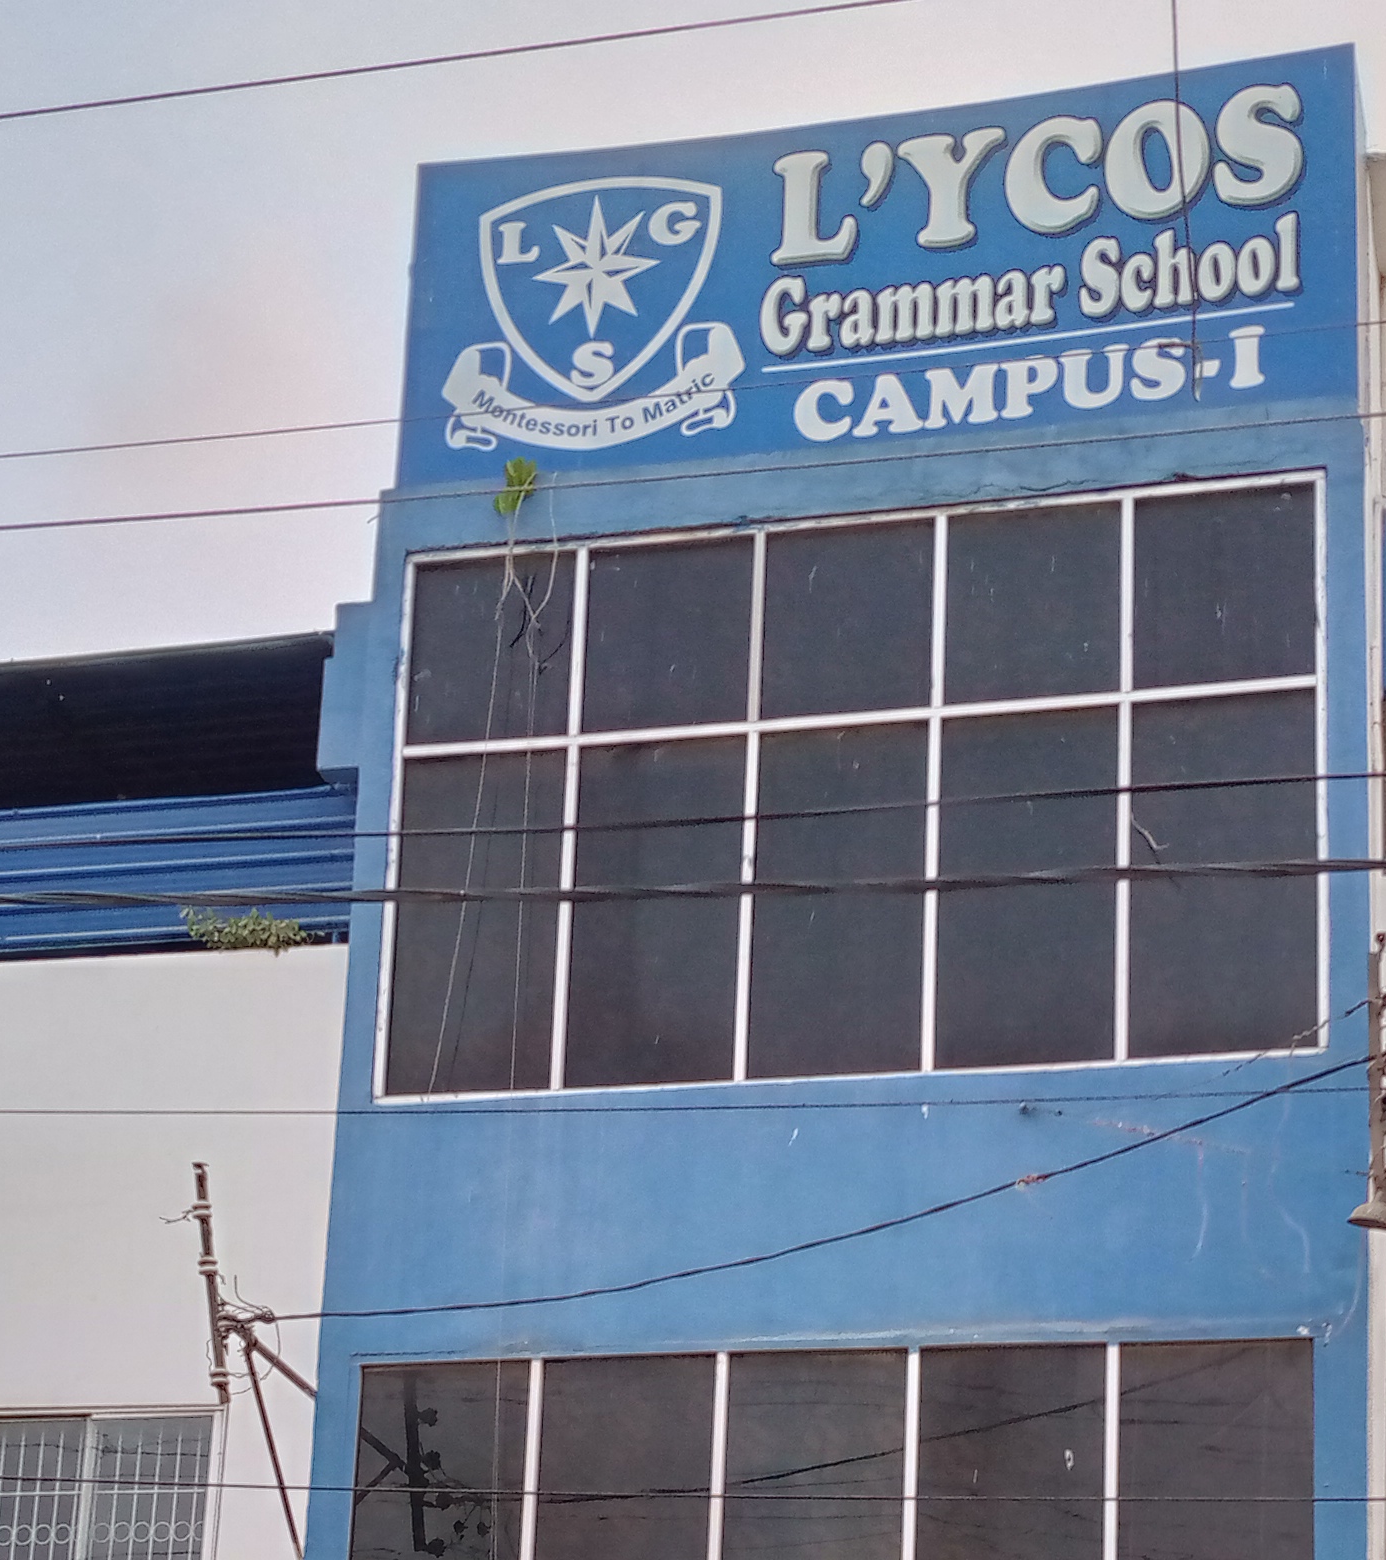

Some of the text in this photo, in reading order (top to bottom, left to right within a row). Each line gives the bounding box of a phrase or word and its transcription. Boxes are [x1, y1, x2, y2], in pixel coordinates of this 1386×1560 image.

[496, 201, 702, 264] L G
[759, 211, 1301, 357] Grammar School
[570, 340, 615, 388] S
[471, 372, 716, 437] Montessori To Matric
